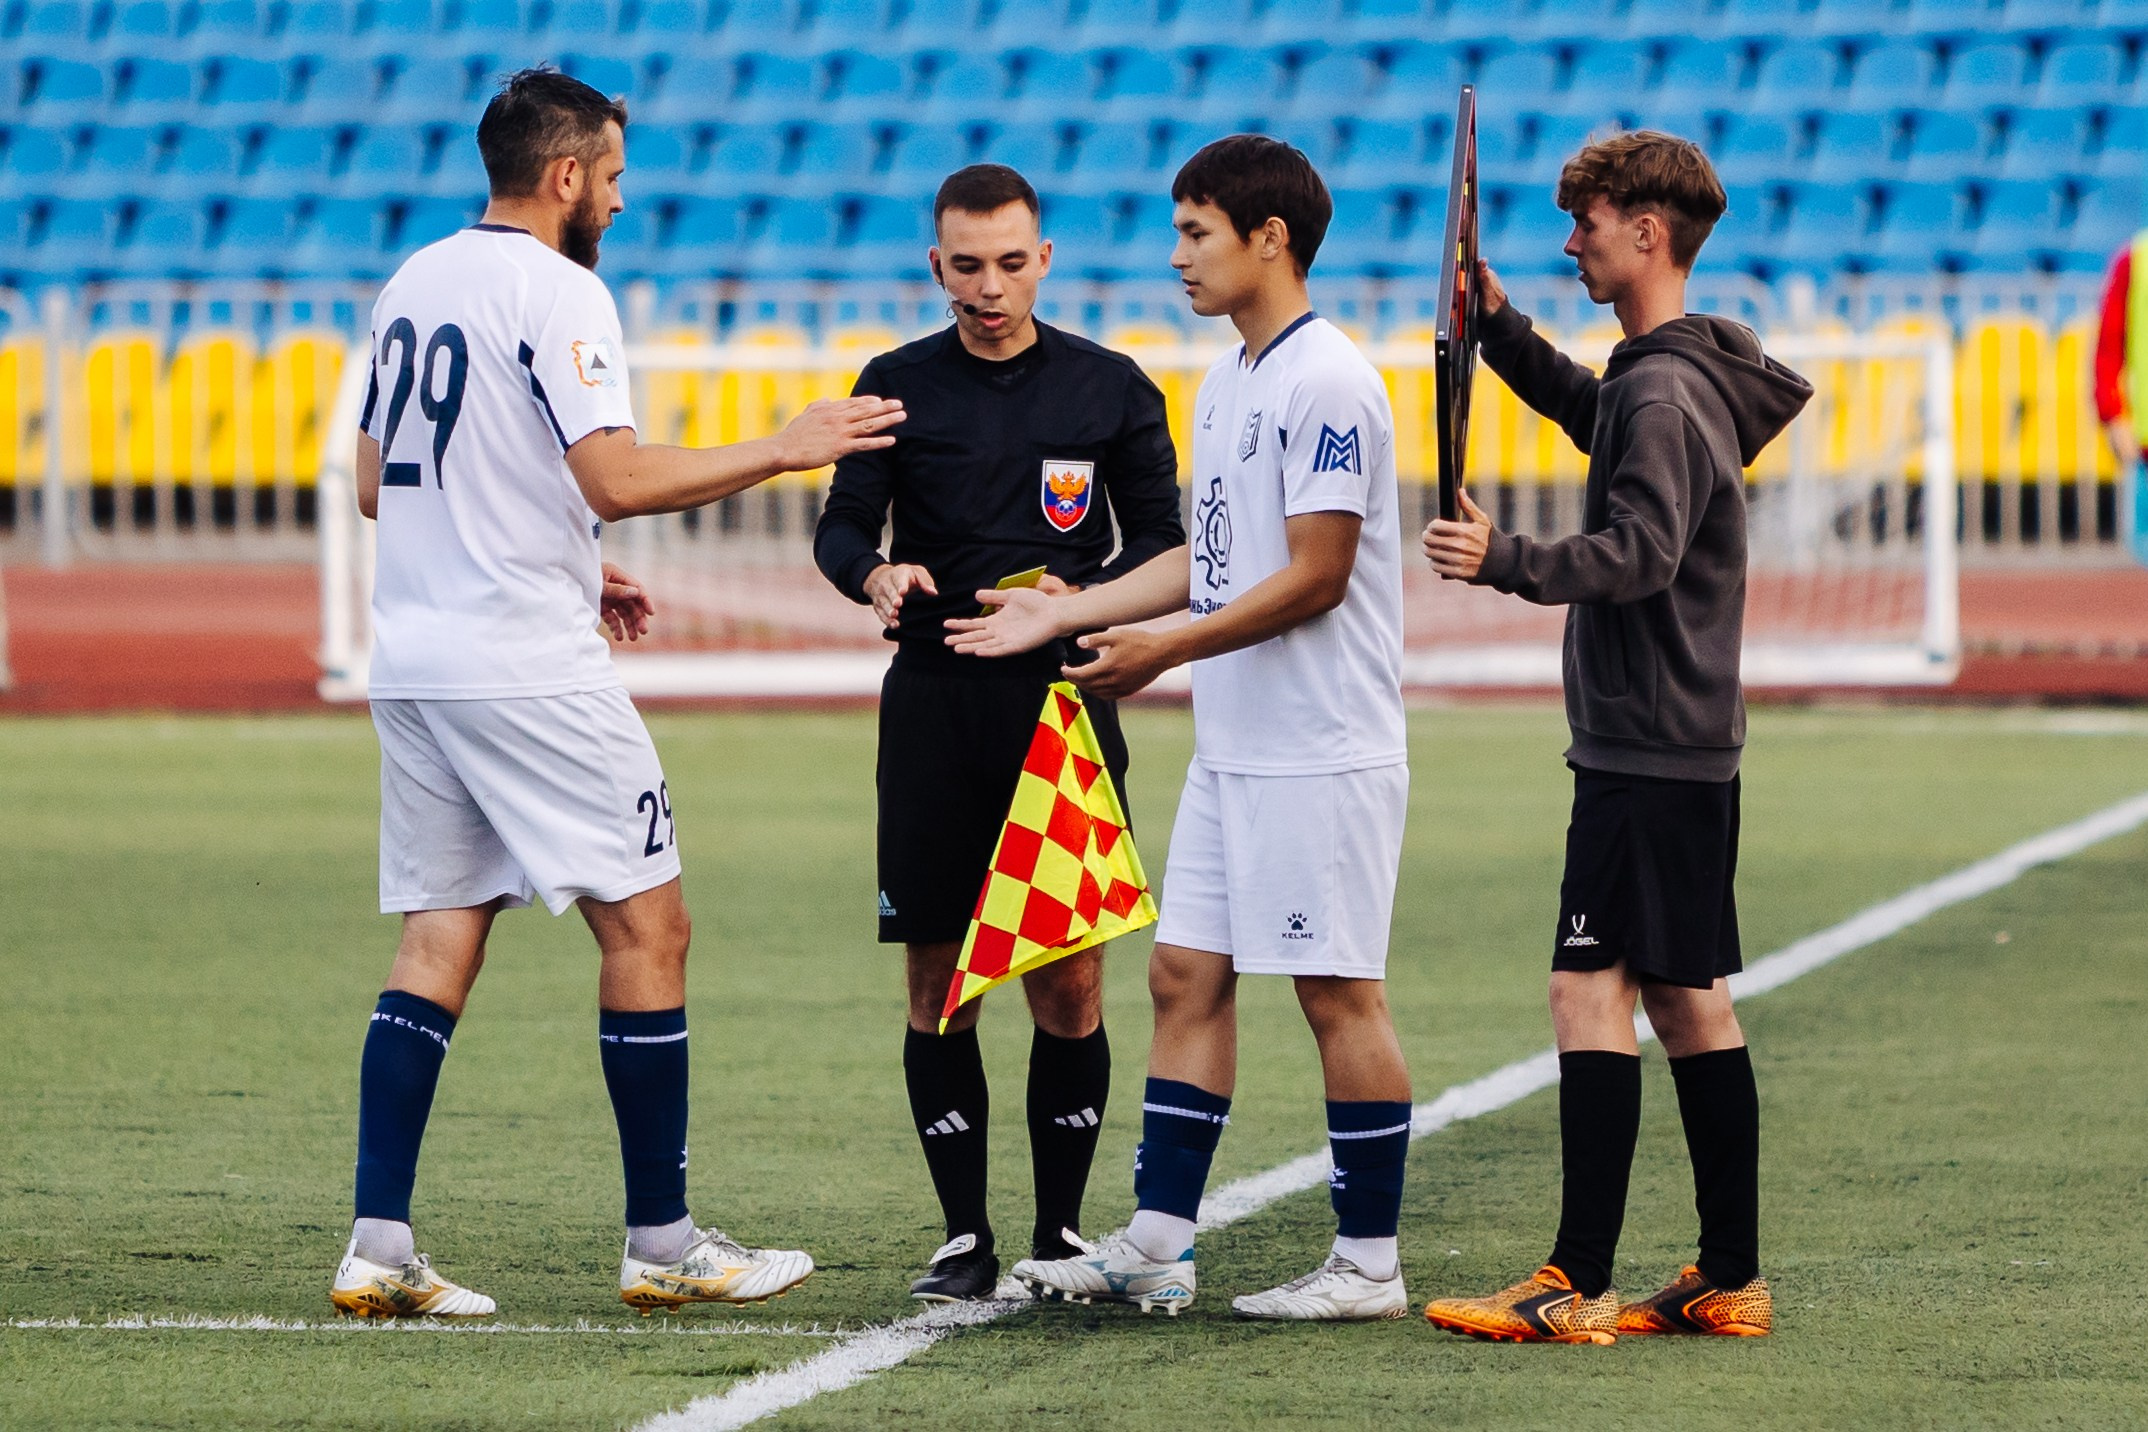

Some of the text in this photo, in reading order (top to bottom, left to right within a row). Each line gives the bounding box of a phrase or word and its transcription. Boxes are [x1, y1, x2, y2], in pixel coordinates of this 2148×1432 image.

[380, 316, 469, 490] 29
[637, 779, 673, 858] 29
[1281, 932, 1314, 940] KELME
[381, 1013, 443, 1043] KELME
